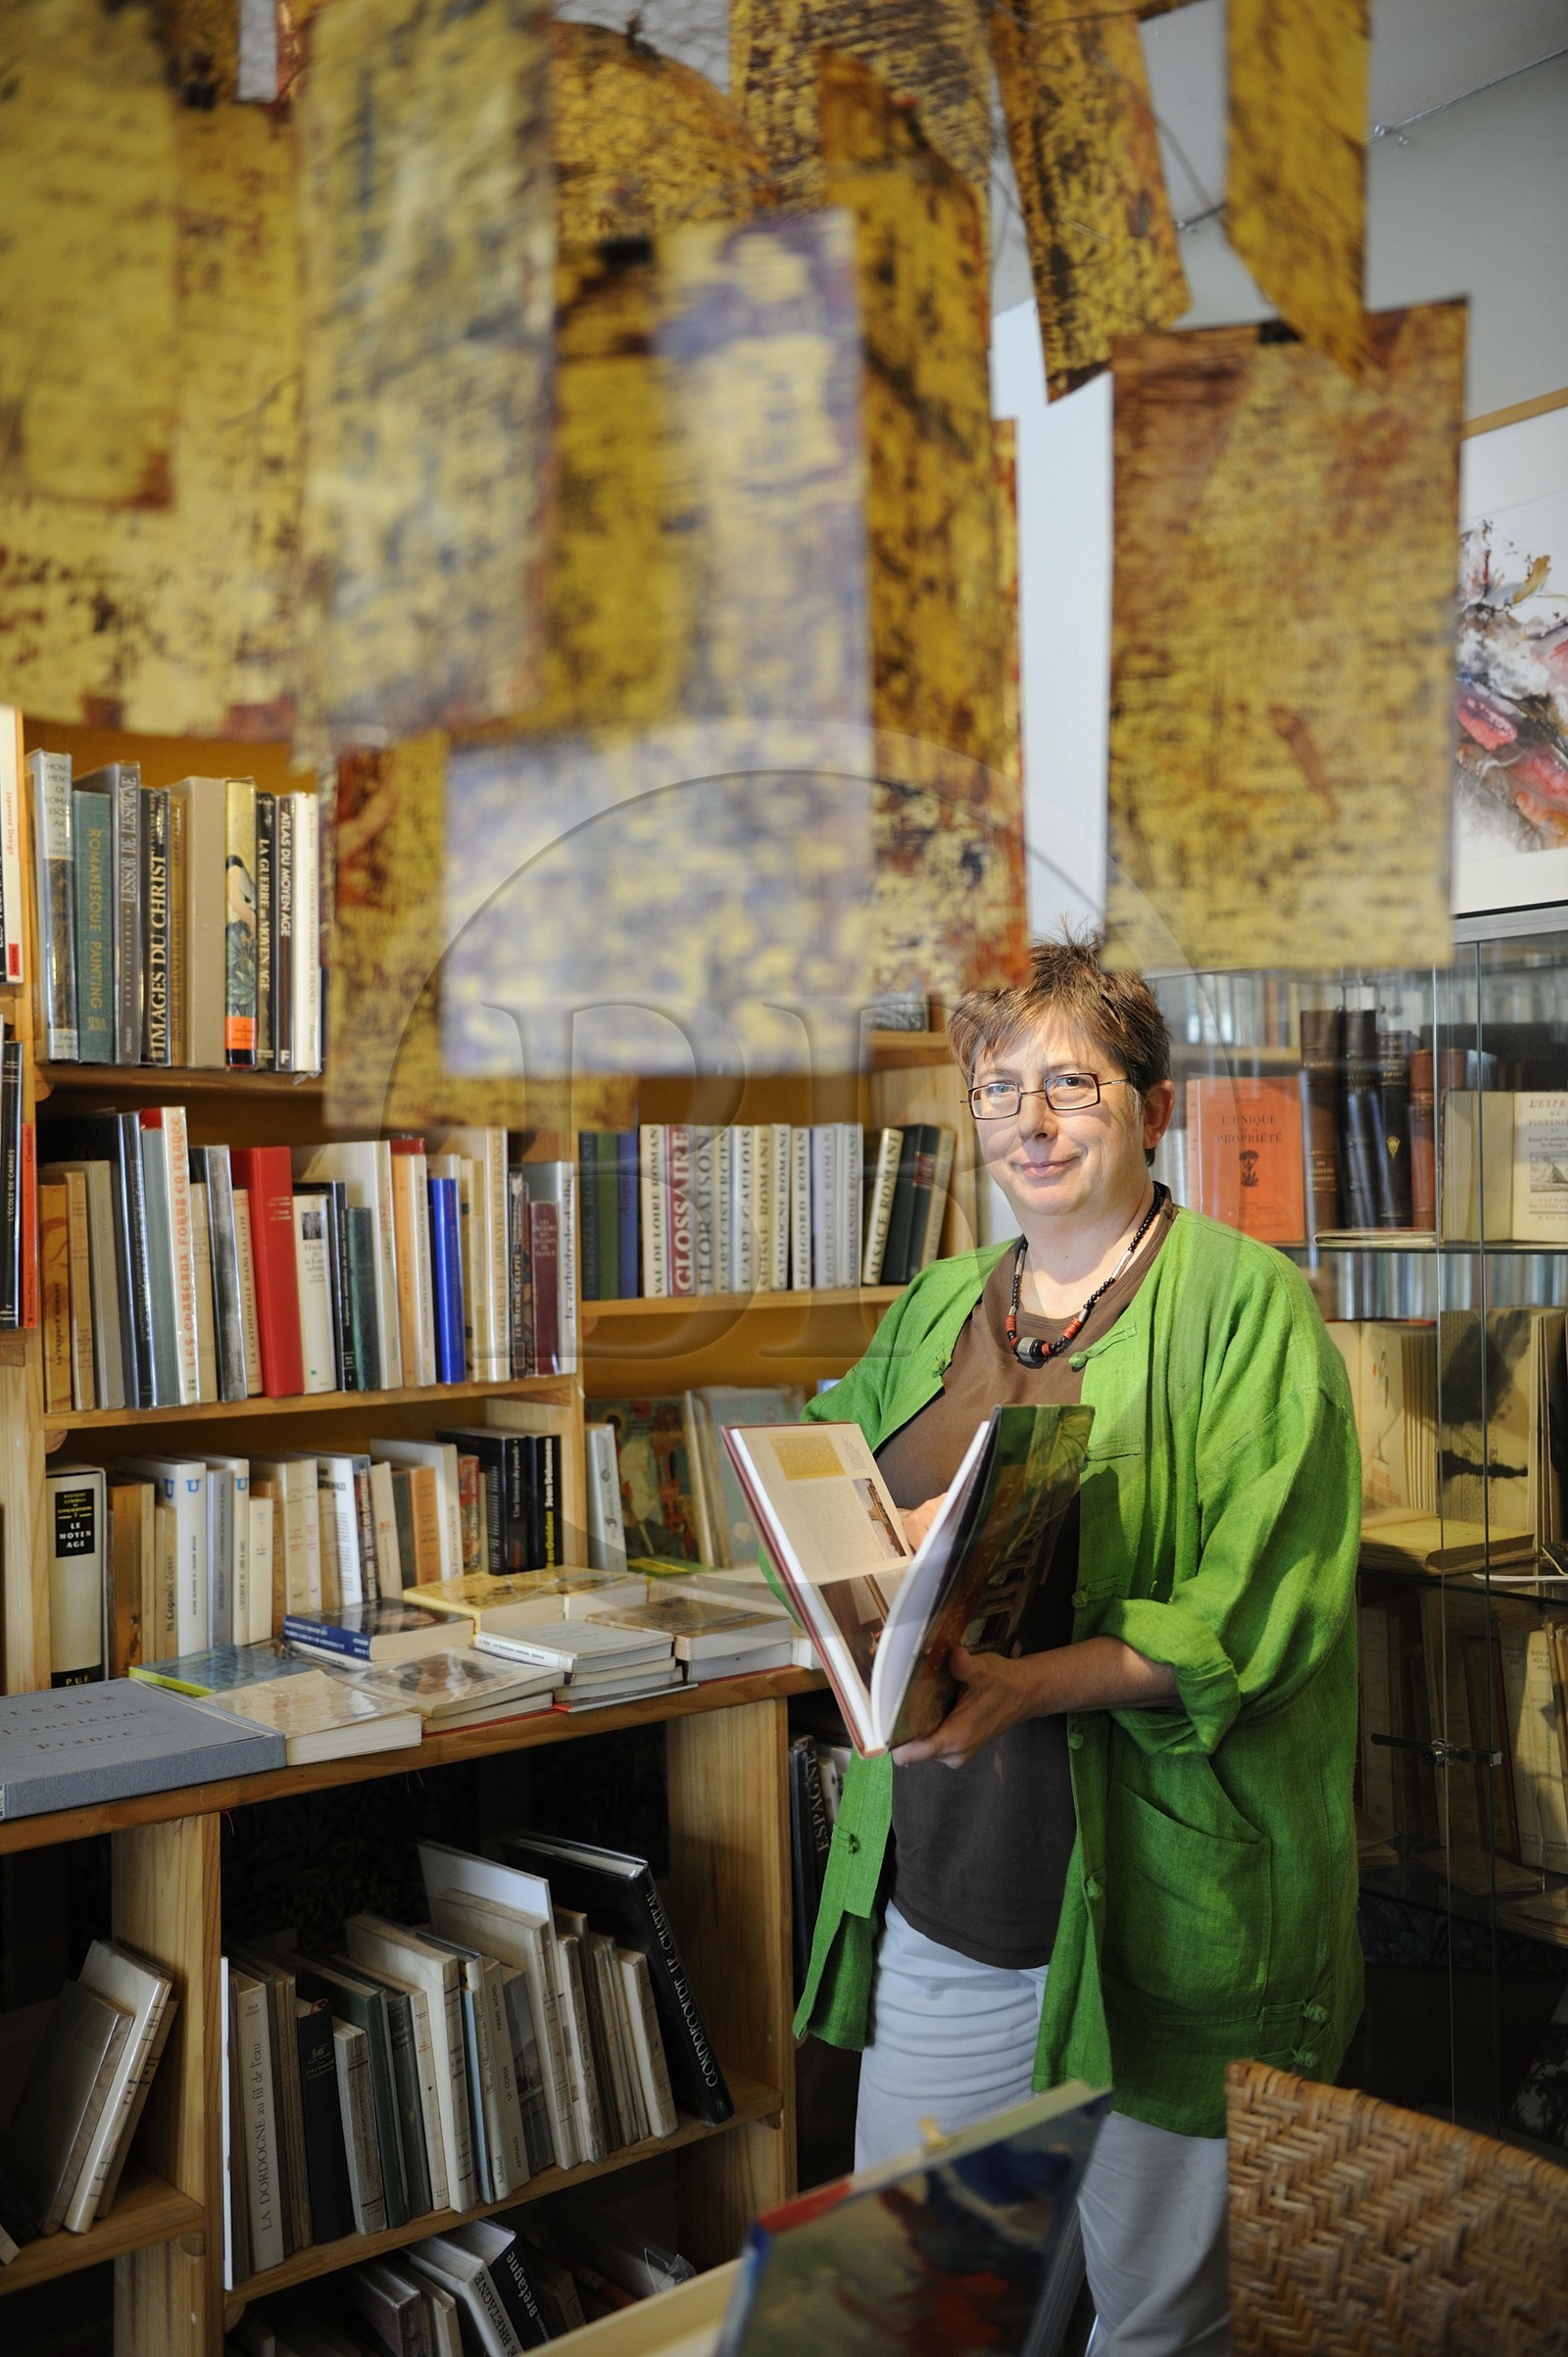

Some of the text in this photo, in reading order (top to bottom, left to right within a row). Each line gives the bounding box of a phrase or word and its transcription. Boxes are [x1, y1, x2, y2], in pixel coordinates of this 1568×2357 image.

[120, 776, 137, 903] L'ESSOR DE L'ESPAGNE
[259, 838, 270, 855] LA
[88, 829, 102, 931] ROMANESQUE
[148, 850, 168, 929] CHRIST
[259, 859, 270, 908] GUERRE
[280, 811, 292, 936] ATLAS DU MOYEN AGE
[149, 933, 168, 965] DU
[259, 920, 270, 962] MOYEN
[89, 941, 103, 1008] PAINTING
[149, 971, 168, 1048] IMAGES
[171, 1116, 185, 1170] FRANCE
[1216, 1132, 1284, 1145] PROPRIÉTÉ
[1221, 1115, 1278, 1127] L'UNIQUE
[492, 1134, 504, 1184] FRANCE
[719, 1131, 729, 1236] CISTERCIEN
[759, 1133, 770, 1215] ROMANE
[8, 1179, 15, 1191] DE
[493, 1190, 504, 1207] DE
[740, 1130, 752, 1285] L'ART GAULOIS
[777, 1130, 788, 1286] CATALOGNE ROMANE
[796, 1131, 808, 1285] PÉRIGORD ROMAN
[869, 1132, 902, 1278] ALSACE ROMANE
[173, 1198, 188, 1246] FORTS
[649, 1128, 663, 1294] VAL DE LOIRE ROMAN
[671, 1131, 693, 1291] GLOSSAIRE
[698, 1134, 714, 1286] FLORAISON
[241, 1240, 249, 1252] LA
[241, 1256, 250, 1282] DANS
[183, 1339, 196, 1367] LES
[250, 1350, 257, 1364] LA
[186, 1478, 202, 1493] U
[235, 1477, 250, 1491] U
[543, 1438, 555, 1507] Jean Delumeau
[59, 1530, 92, 1540] MOYEN
[66, 1540, 85, 1548] AGE
[70, 1521, 81, 1530] LE
[2, 1708, 150, 1736] l'ancienne
[36, 1730, 135, 1750] France
[807, 1750, 830, 1851] ESPAGNE
[502, 2065, 514, 2101] LA CORSE
[250, 2042, 273, 2232] LA DORDOGNE au fil de l'eau
[512, 2136, 523, 2169] ARTHAUD
[506, 2250, 538, 2318] Bretagne
[472, 2271, 514, 2348] BRETAGNE
